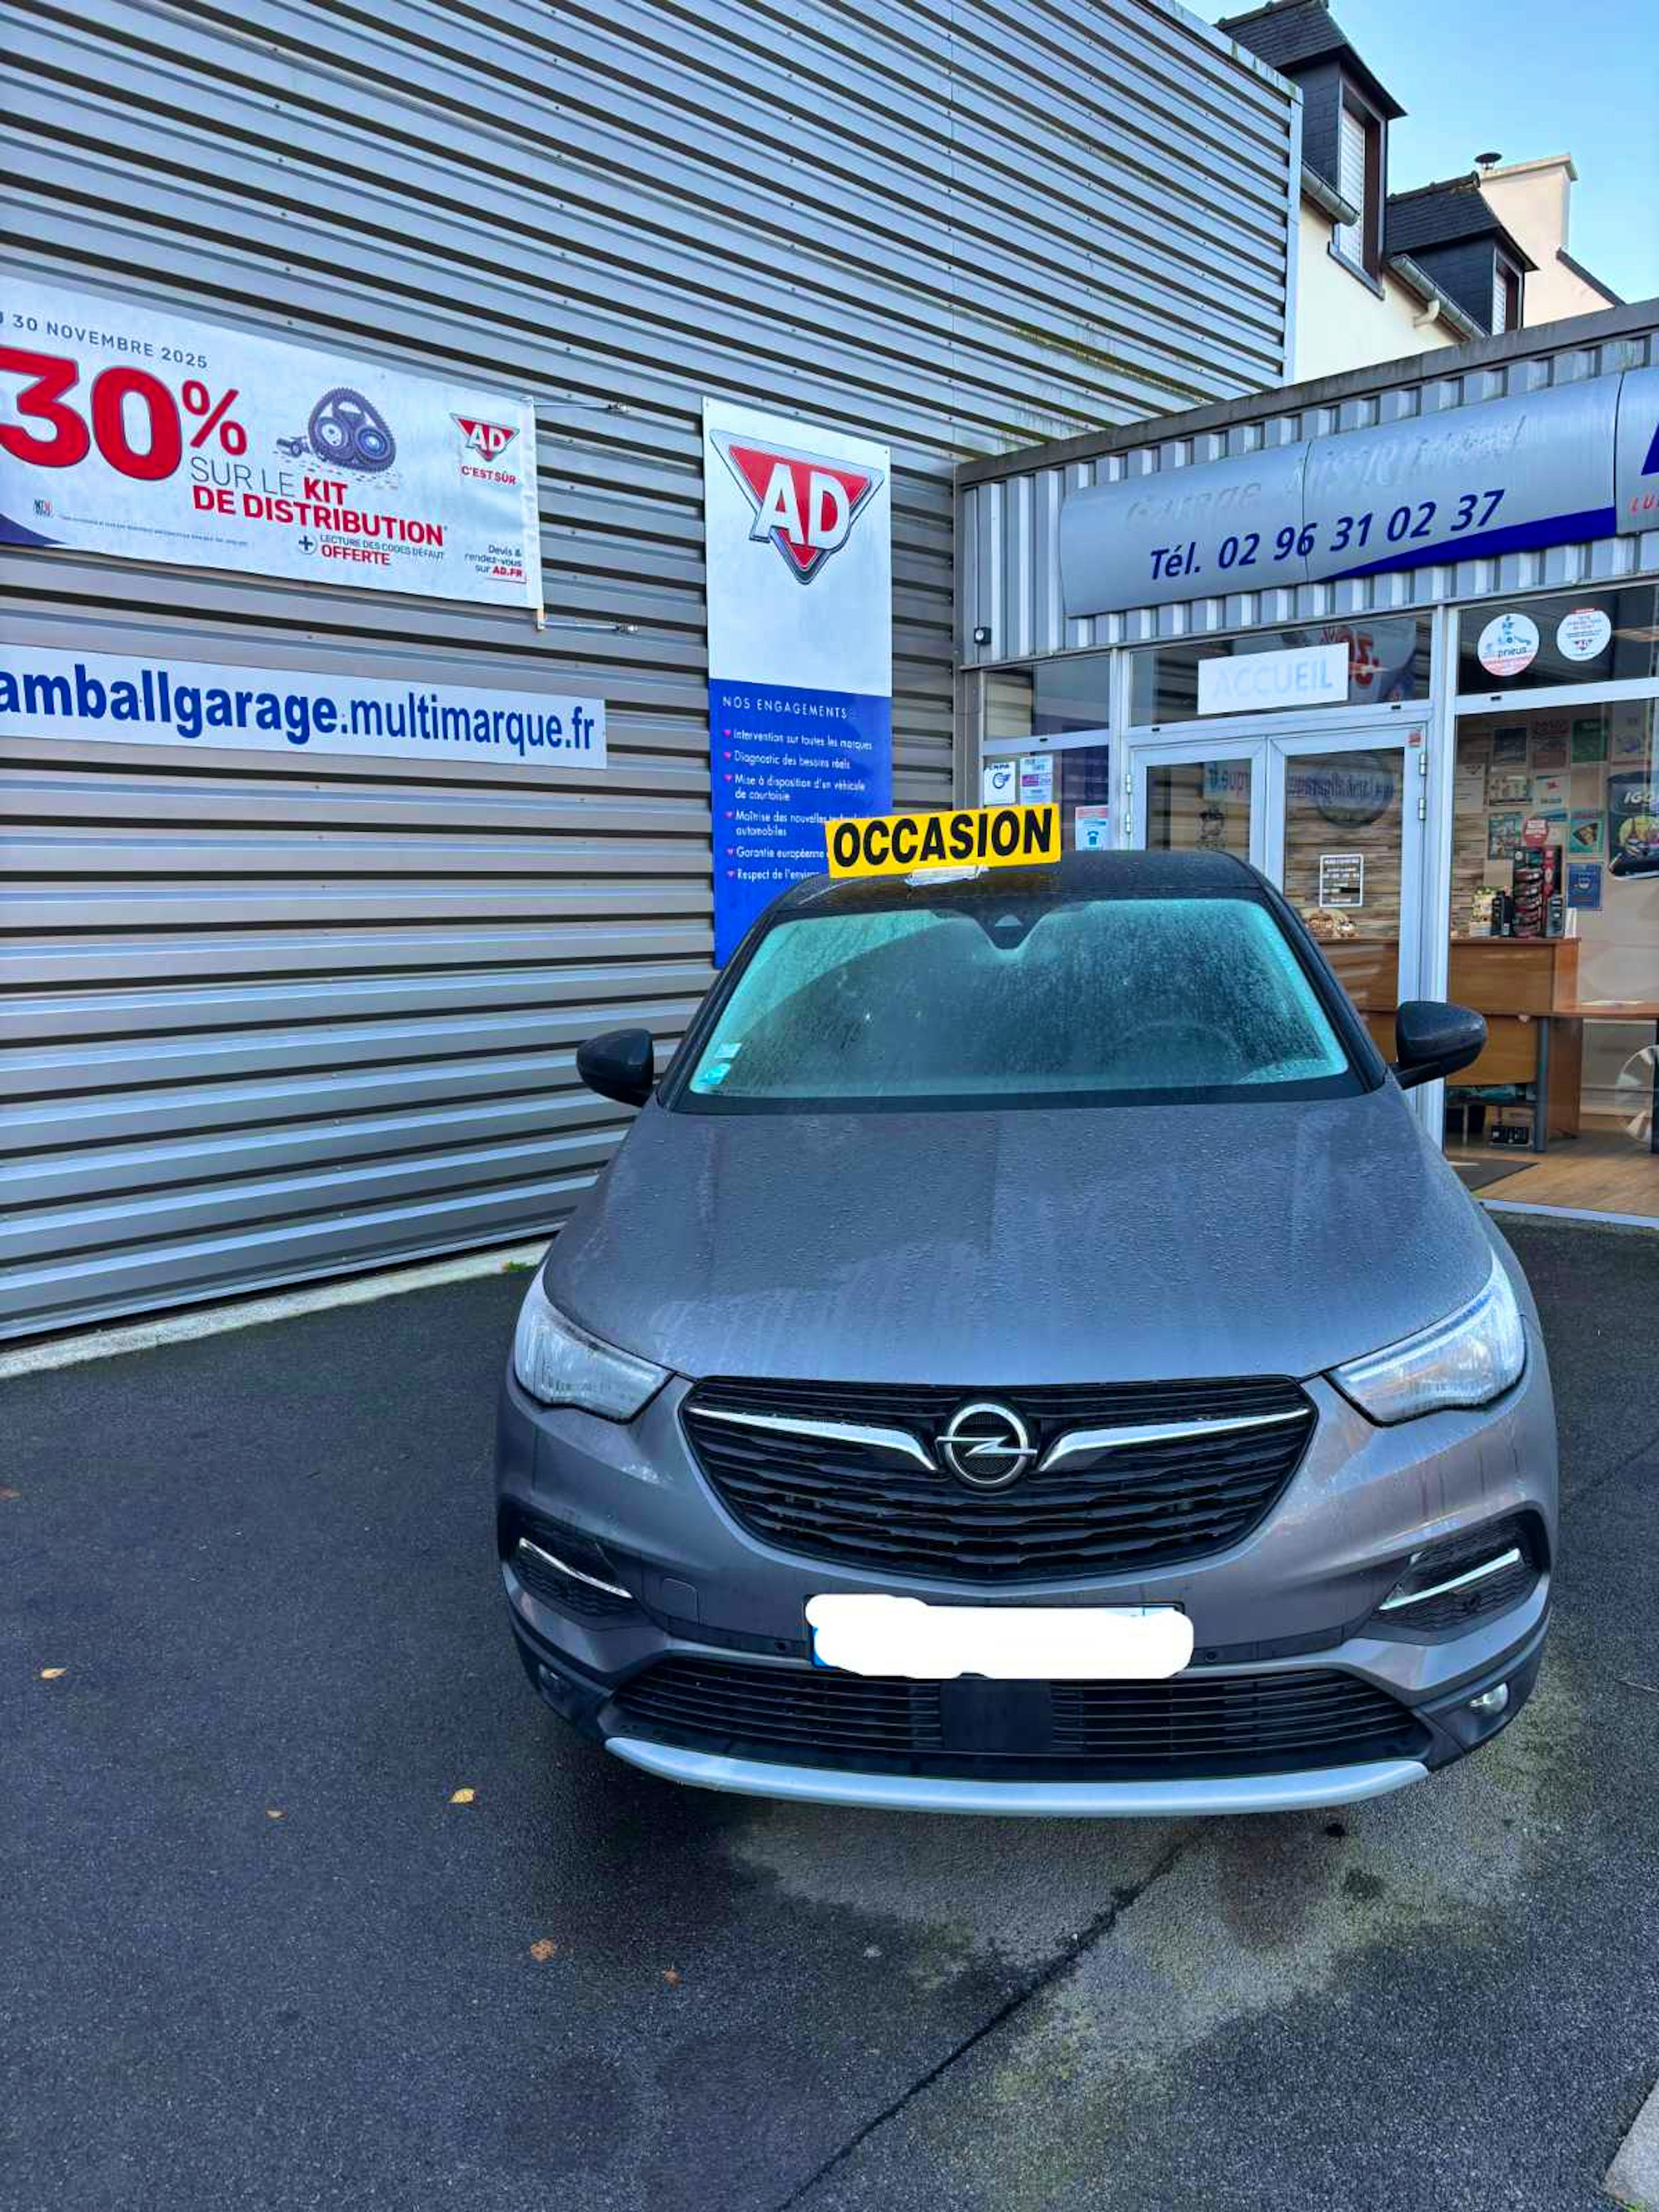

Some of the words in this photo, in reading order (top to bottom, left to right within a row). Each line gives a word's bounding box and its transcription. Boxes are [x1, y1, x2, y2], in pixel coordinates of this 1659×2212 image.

[13, 314, 38, 331] 30
[46, 322, 155, 357] NOVEMBRE
[161, 347, 208, 369] 2025
[467, 424, 506, 453] AD
[190, 456, 252, 491] SUR
[261, 468, 296, 498] LE
[303, 476, 348, 505] KIT
[461, 466, 493, 480] C'EST
[192, 485, 238, 515] DE
[243, 493, 444, 547] DISTRIBUTION
[753, 463, 850, 551] AD
[320, 534, 361, 548] LECTURE
[362, 540, 381, 549] DES
[382, 543, 411, 555] CODES
[1150, 542, 1201, 580] Tél.
[1218, 533, 1261, 569] 02
[1273, 522, 1318, 561] 96
[1329, 514, 1372, 553] 31
[1387, 502, 1437, 542] 02
[1449, 489, 1506, 532] 37
[321, 544, 391, 566] OFFERTE
[489, 544, 513, 556] Devis
[475, 565, 490, 574] sur
[493, 566, 523, 577] AD.FR
[1213, 658, 1333, 697] ACCUEIL
[722, 696, 750, 709] NOS
[756, 698, 847, 719] ENGAGEMENTS
[734, 729, 783, 742] Intervention
[786, 735, 799, 744] sur
[801, 735, 825, 747] toutes
[827, 735, 838, 747] les
[840, 740, 872, 752] marques
[734, 750, 781, 766] Diagnostic
[782, 753, 797, 766] des
[799, 756, 829, 768] besoins
[734, 774, 756, 785] Mise
[759, 775, 764, 786] à
[767, 774, 811, 790] disposition
[834, 779, 865, 792] véhicule
[735, 787, 747, 799] de
[749, 790, 791, 801] courtoisie
[736, 808, 771, 822] Maîtrise
[773, 811, 788, 822] des
[736, 823, 787, 836] automobiles
[833, 808, 1052, 868] OCCASION
[736, 845, 775, 858] Garantie
[777, 848, 825, 860] européenne
[737, 868, 770, 883] Respect
[772, 868, 783, 880] de
